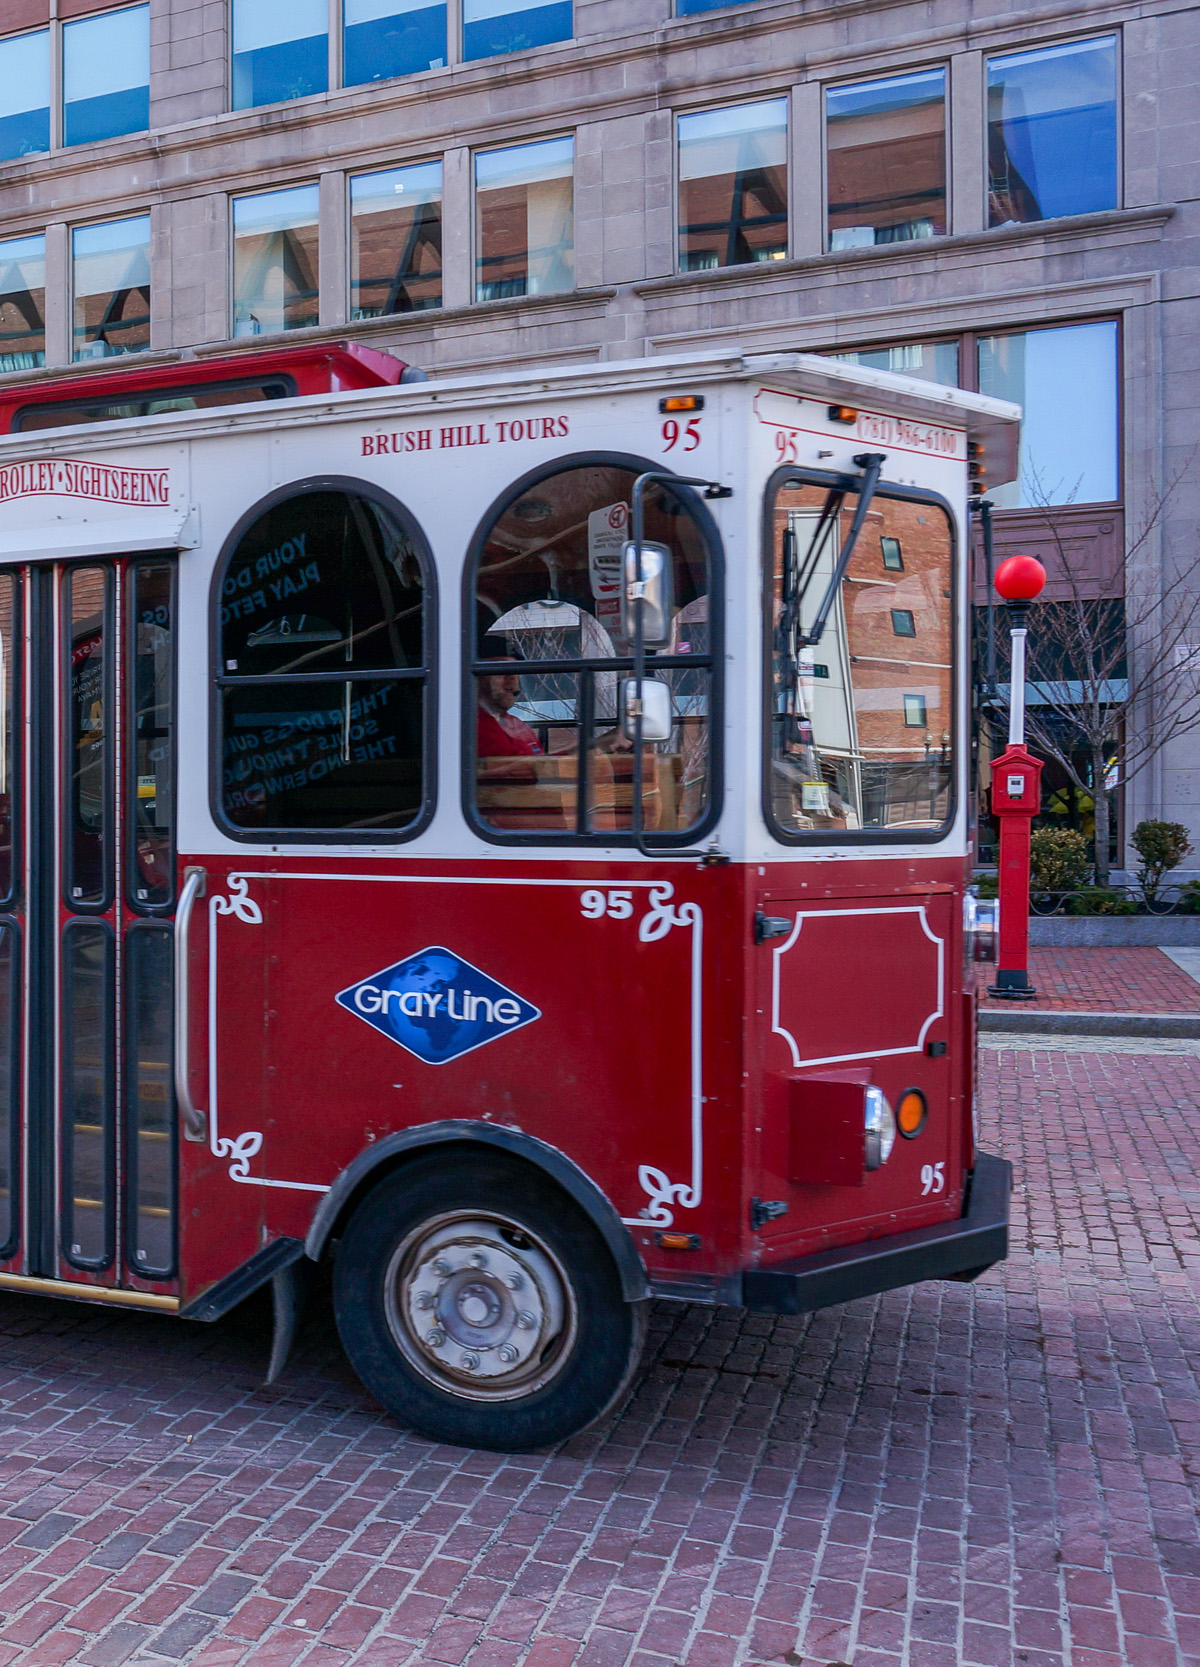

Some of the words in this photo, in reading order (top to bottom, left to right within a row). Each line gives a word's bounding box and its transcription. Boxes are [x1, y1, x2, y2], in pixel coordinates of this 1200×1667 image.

[360, 429, 432, 457] BRUSH
[439, 423, 490, 449] HILL
[495, 415, 570, 443] TOURS
[661, 417, 703, 453] 95
[775, 430, 800, 464] 95
[856, 414, 894, 445] (781)
[64, 462, 170, 503] SIGHTSEEING
[580, 889, 634, 920] 95
[447, 988, 522, 1025] Line
[919, 1161, 946, 1197] 95
